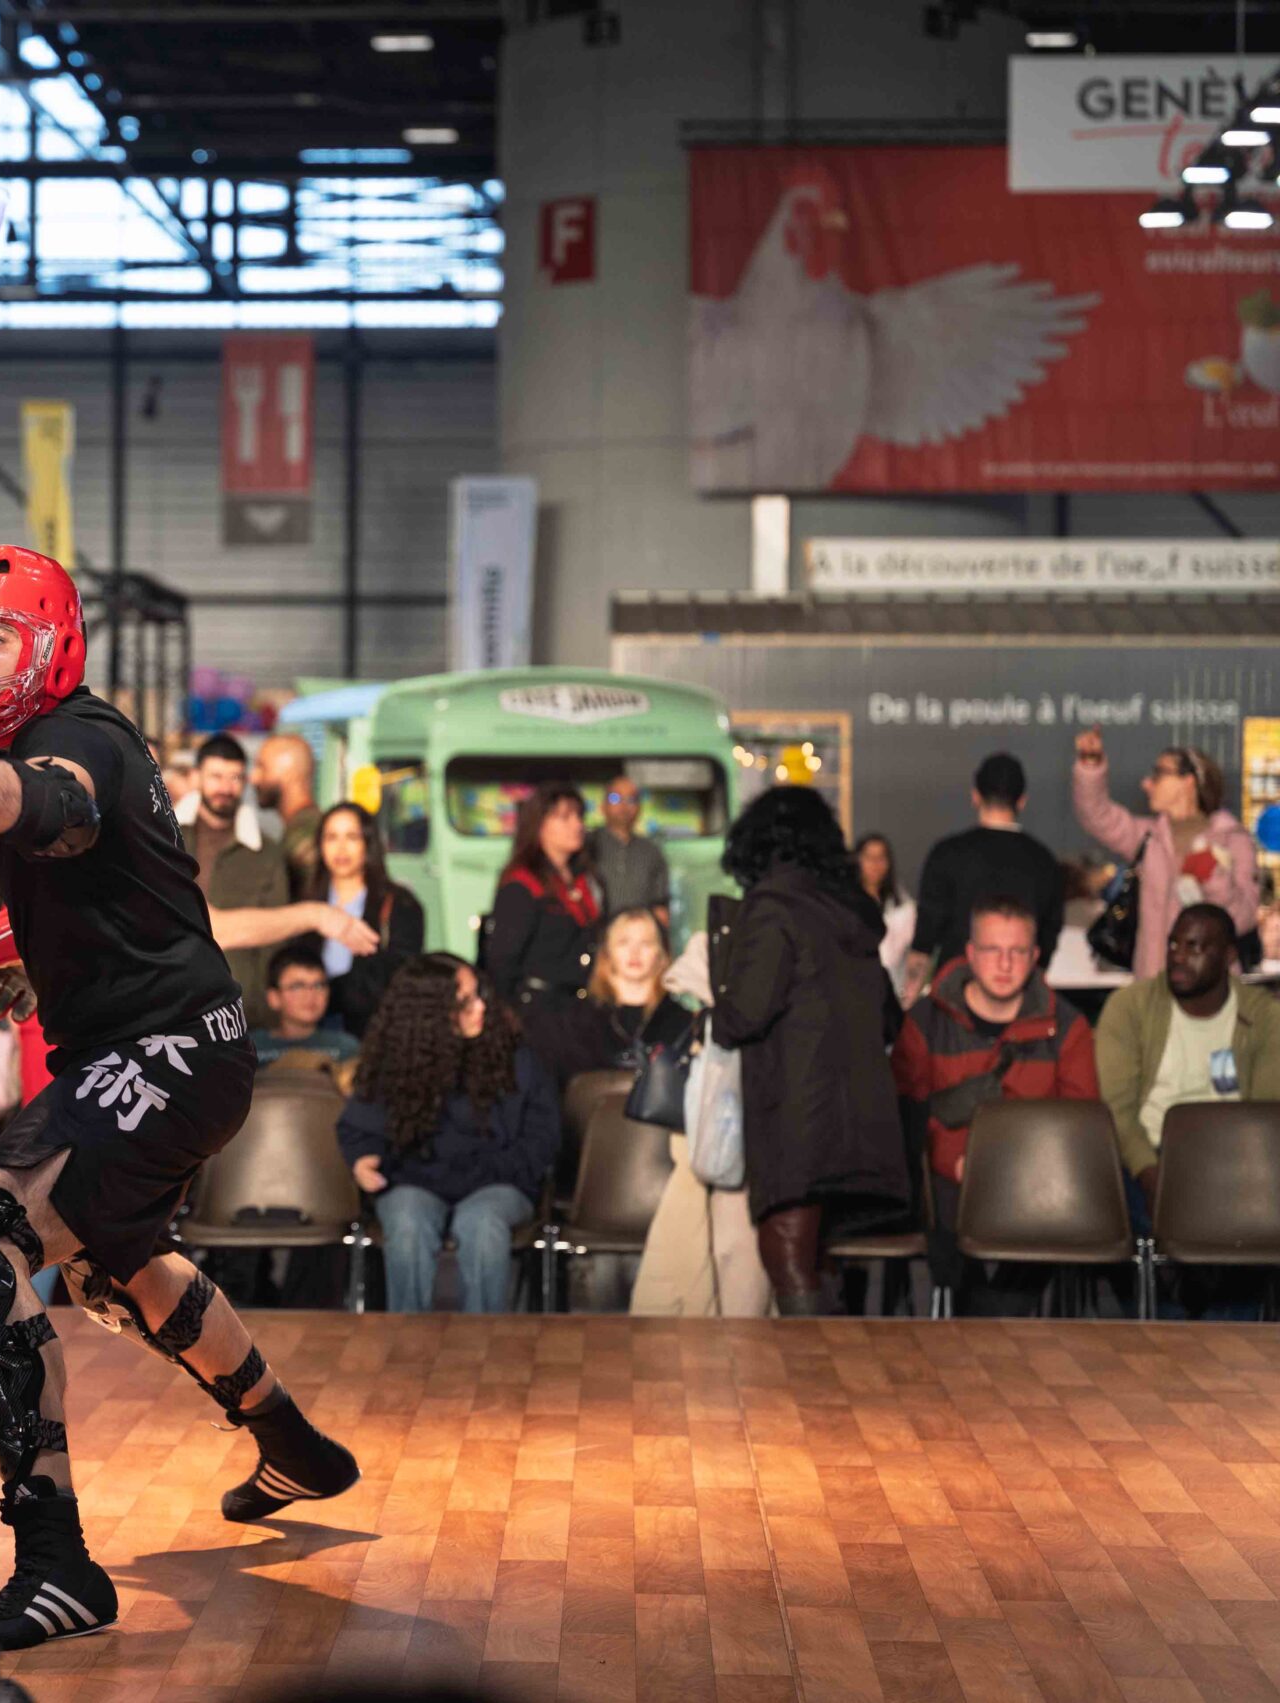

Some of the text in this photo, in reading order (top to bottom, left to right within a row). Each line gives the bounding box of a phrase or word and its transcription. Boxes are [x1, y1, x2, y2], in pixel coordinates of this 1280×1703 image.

[552, 206, 585, 264] F
[841, 547, 869, 575] la
[876, 547, 1041, 576] découverte
[1049, 547, 1084, 576] de
[1190, 548, 1280, 576] suisse
[868, 691, 1239, 729] De la poule à l'oeuf suisse
